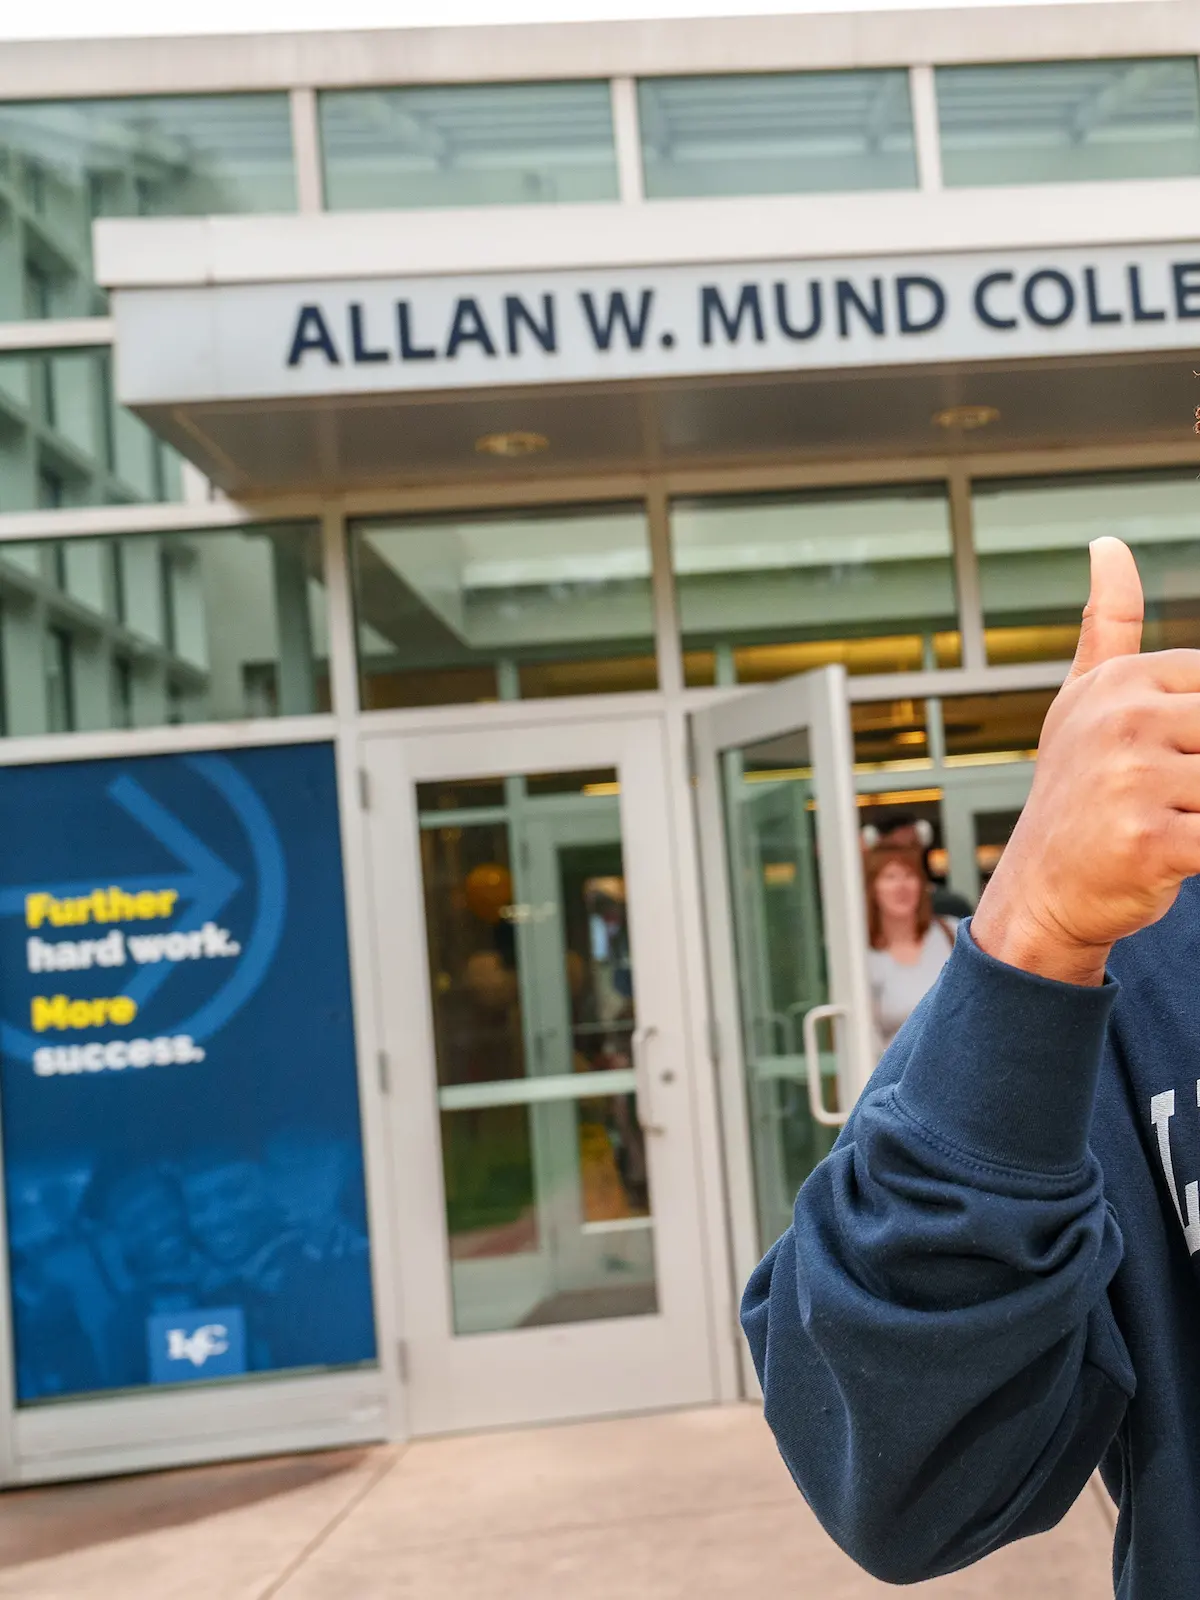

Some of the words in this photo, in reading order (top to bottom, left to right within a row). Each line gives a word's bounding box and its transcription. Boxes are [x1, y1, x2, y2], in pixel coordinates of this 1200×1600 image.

[286, 292, 557, 368] ALLAN
[577, 288, 677, 353] W.
[701, 275, 947, 347] MUND
[25, 886, 179, 930] Further
[26, 928, 127, 973] hard
[127, 920, 242, 963] work.
[31, 993, 138, 1033] More
[33, 1033, 206, 1077] success.
